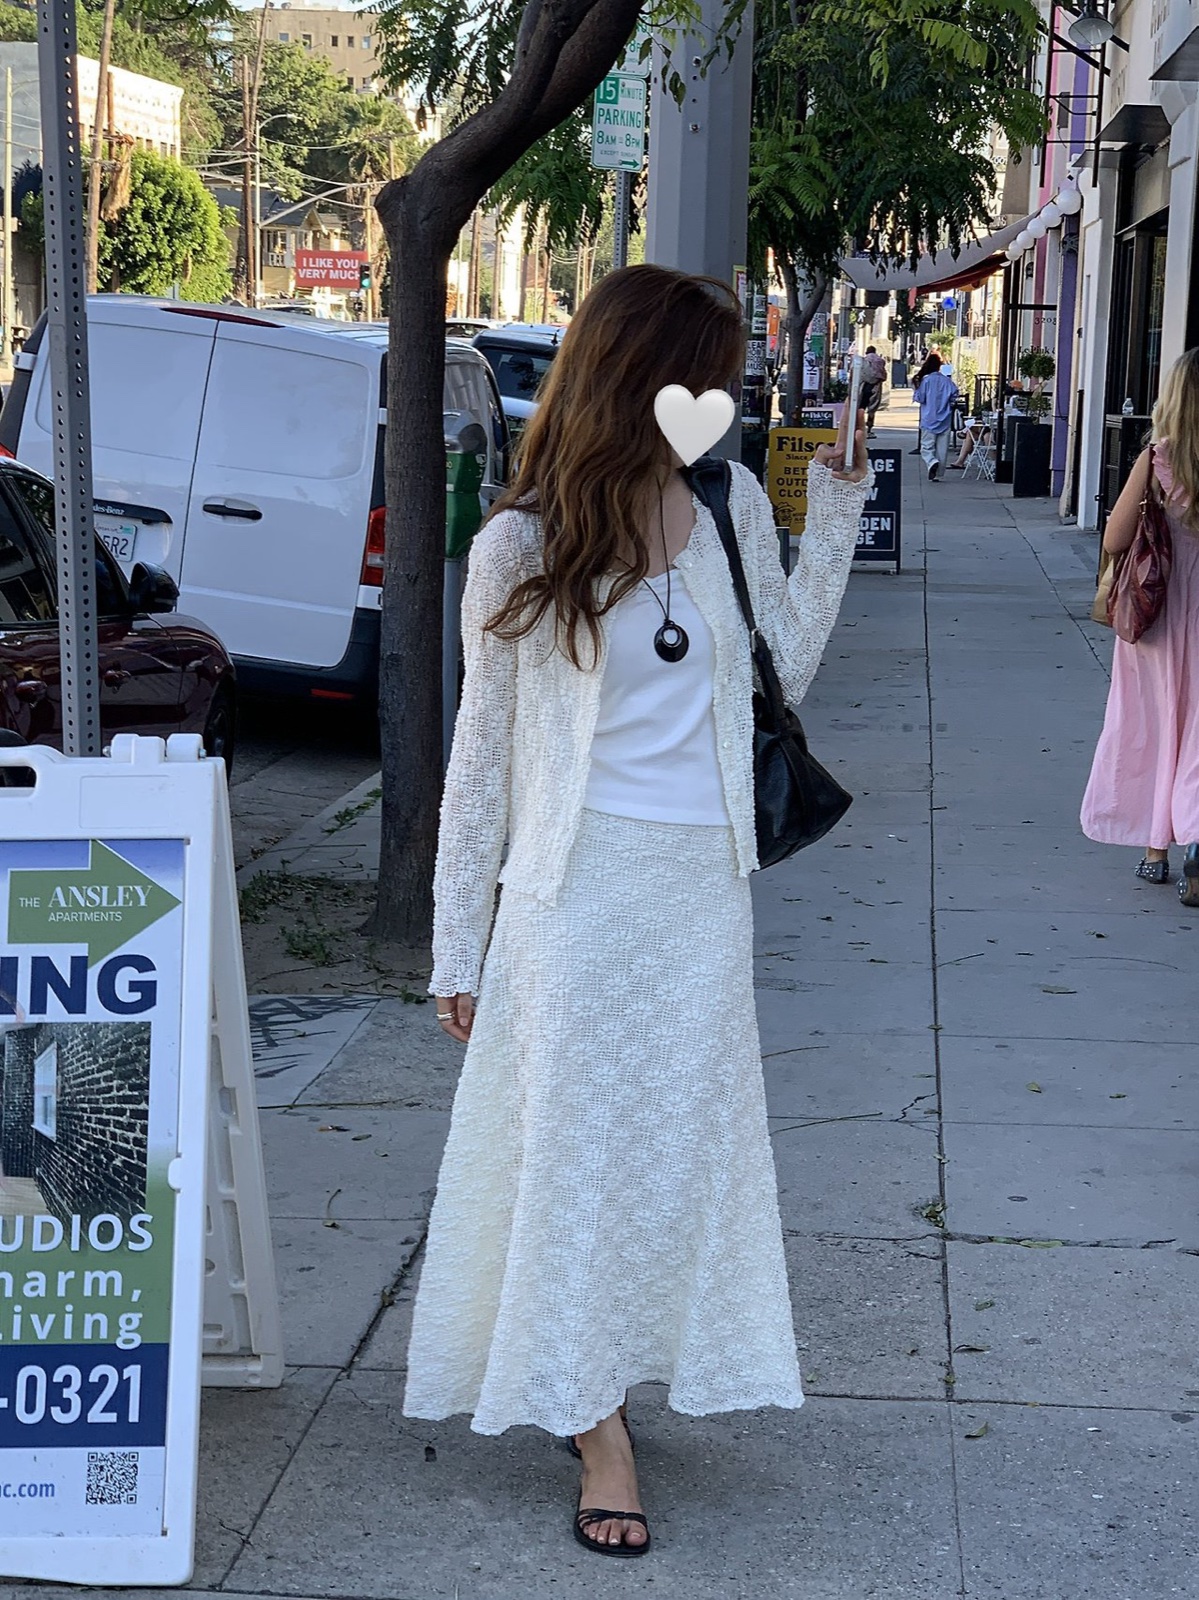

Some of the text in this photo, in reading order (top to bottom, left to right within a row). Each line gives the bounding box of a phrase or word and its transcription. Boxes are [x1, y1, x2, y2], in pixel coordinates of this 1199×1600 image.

[600, 81, 643, 100] 15 MINUTE
[597, 107, 642, 128] PARKING
[597, 130, 617, 145] 8AM
[625, 133, 640, 148] 8PM
[302, 257, 359, 269] I LIKE YOU
[298, 268, 328, 279] VERY
[19, 885, 152, 908] THE ANSLEY
[48, 911, 122, 922] APARTMENTS
[0, 1304, 143, 1350] iving
[0, 1482, 55, 1498] c.com
